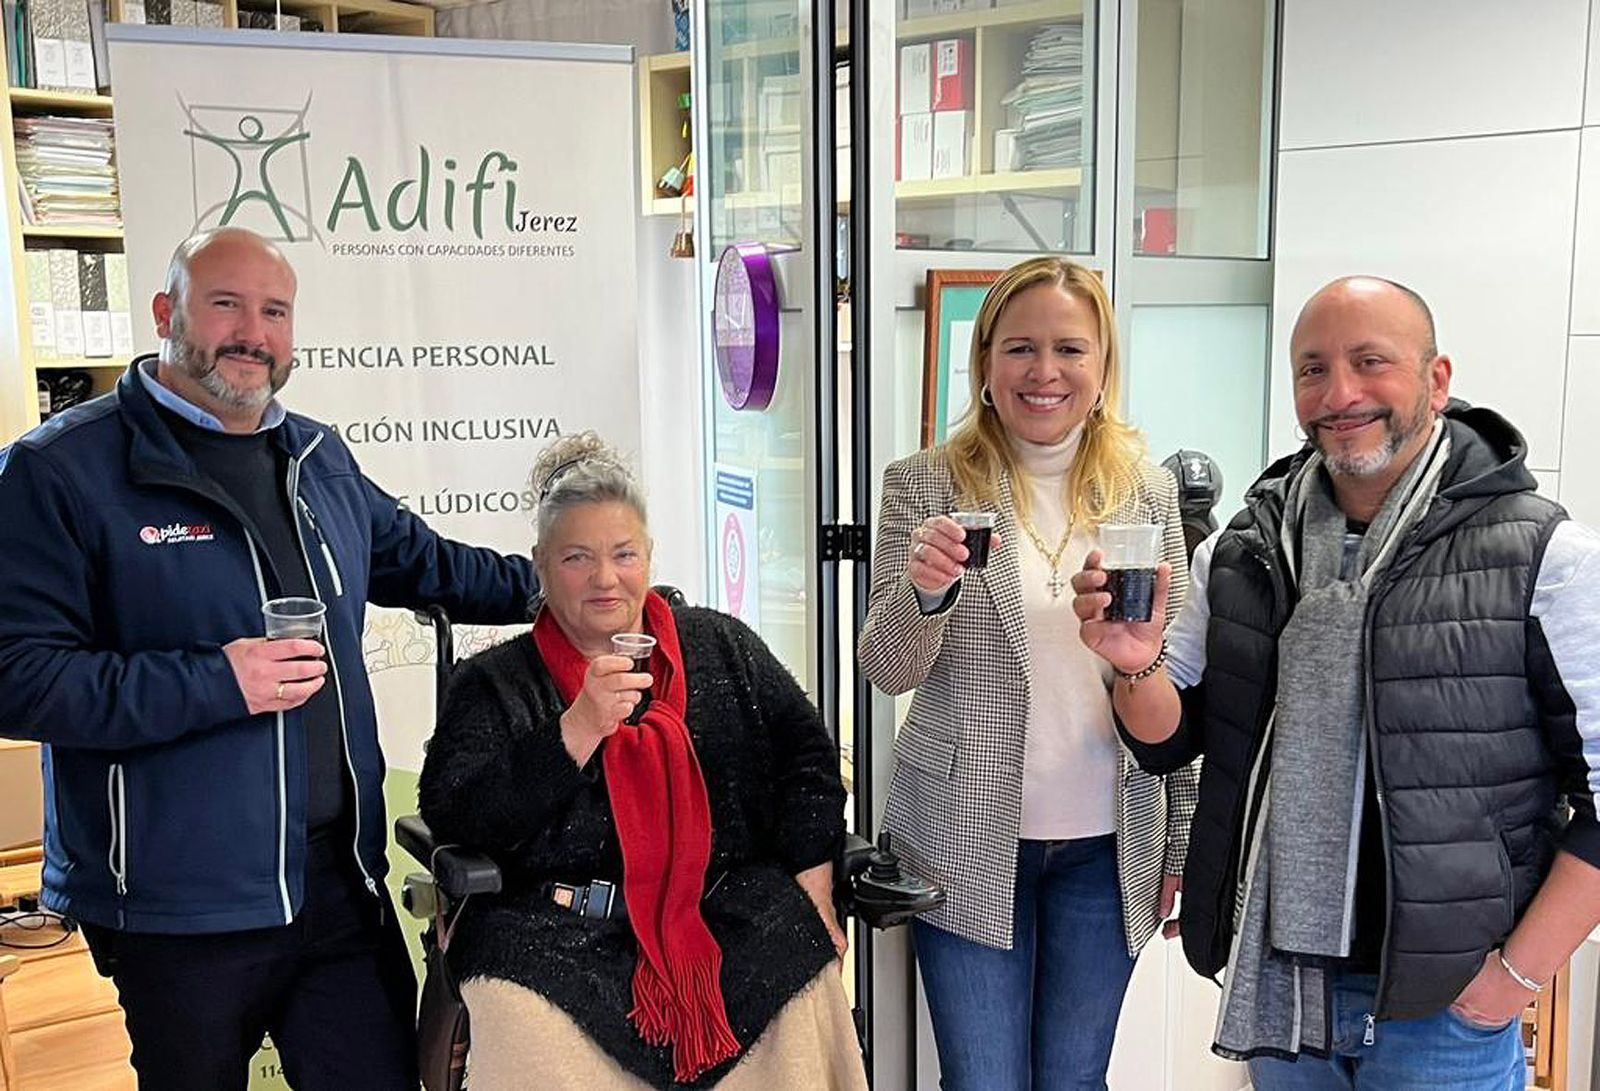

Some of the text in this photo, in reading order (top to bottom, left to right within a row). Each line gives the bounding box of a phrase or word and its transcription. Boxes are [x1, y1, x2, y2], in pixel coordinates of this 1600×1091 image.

[327, 144, 518, 240] Adifi
[515, 210, 578, 233] Jerez
[332, 243, 575, 257] PERSONAS CON CAPACIDADES DIFERENTES
[290, 344, 555, 369] STENCIA PERSONAL
[423, 418, 560, 442] INCLUSIVA
[420, 488, 536, 515] LÚDICOS
